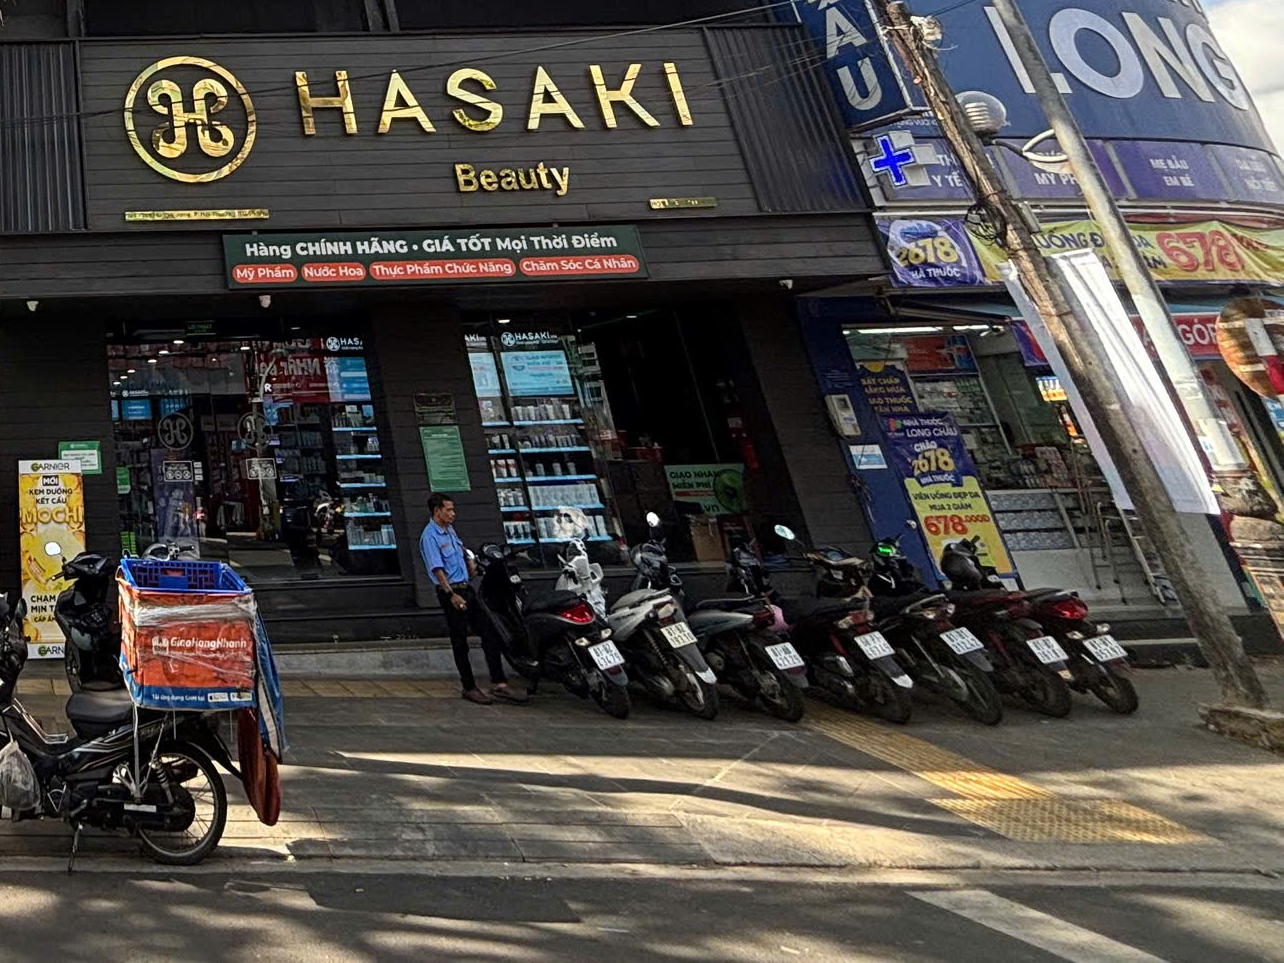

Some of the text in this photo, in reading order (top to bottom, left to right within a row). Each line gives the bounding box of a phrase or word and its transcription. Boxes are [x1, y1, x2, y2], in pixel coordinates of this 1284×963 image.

[983, 7, 1250, 111] LONG
[295, 62, 694, 136] HASAKI
[454, 160, 570, 196] Beauty
[931, 171, 964, 187] Y TẾ
[245, 231, 617, 259] Hàng CHÍNH HÃNG GIÁ TỐT Mọi Thời Điểm
[896, 236, 960, 268] 2678
[1154, 229, 1245, 273] 678
[304, 263, 364, 278] Nước Hoa
[372, 259, 513, 278] Thực Phẩm Chức Năng
[522, 255, 636, 272] Chăm Sóc Cá Nhân
[927, 264, 961, 278] THUỐC
[236, 264, 294, 281] Mỹ Phẩm
[905, 425, 959, 438] LONG CHÂU
[42, 475, 59, 487] MỚI
[29, 488, 46, 496] KEM
[35, 494, 69, 505] KẾT CẤU
[928, 502, 953, 512] MUA 2
[21, 507, 85, 527] MOCHI
[30, 604, 48, 616] MỊN
